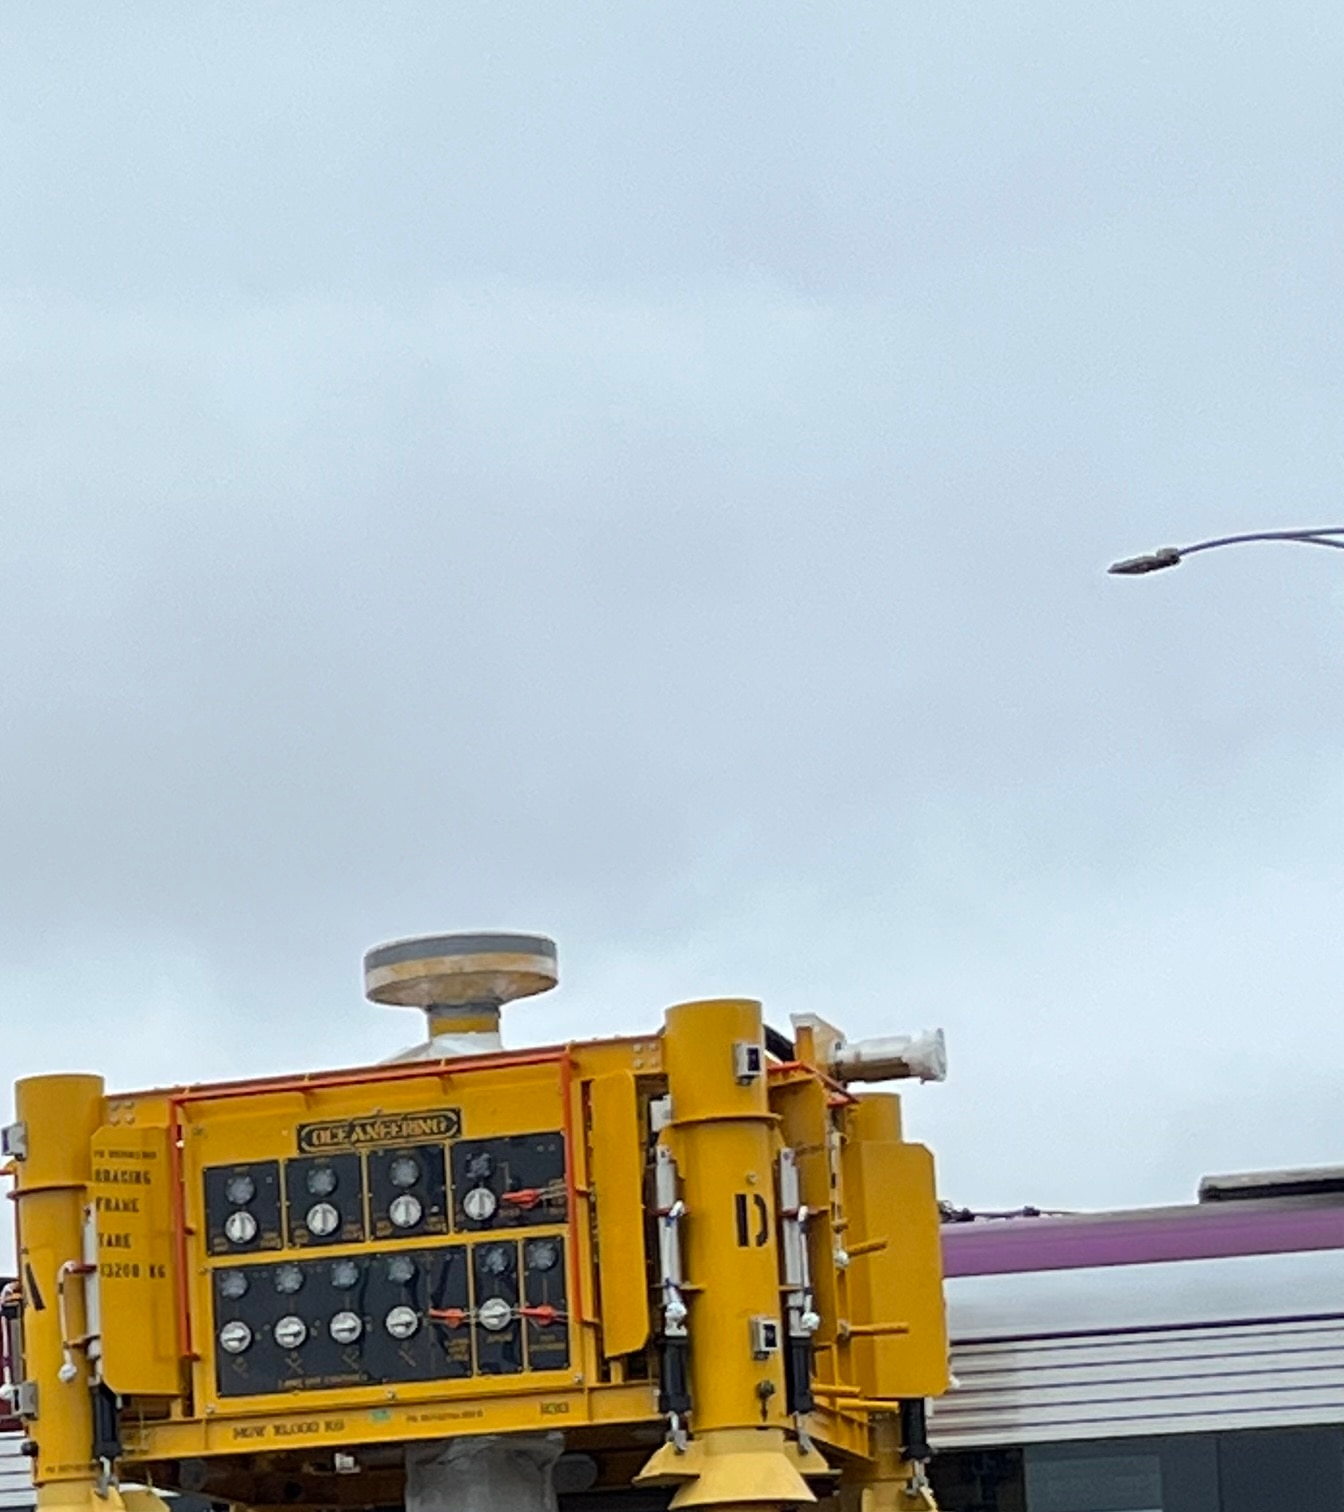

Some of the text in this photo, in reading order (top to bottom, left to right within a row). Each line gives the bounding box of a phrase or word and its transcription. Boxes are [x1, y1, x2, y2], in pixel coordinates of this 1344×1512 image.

[94, 1168, 152, 1186] BRACING
[95, 1196, 140, 1213] FRAME
[734, 1193, 770, 1248] D
[98, 1232, 132, 1249] TARE
[149, 1262, 166, 1278] KG
